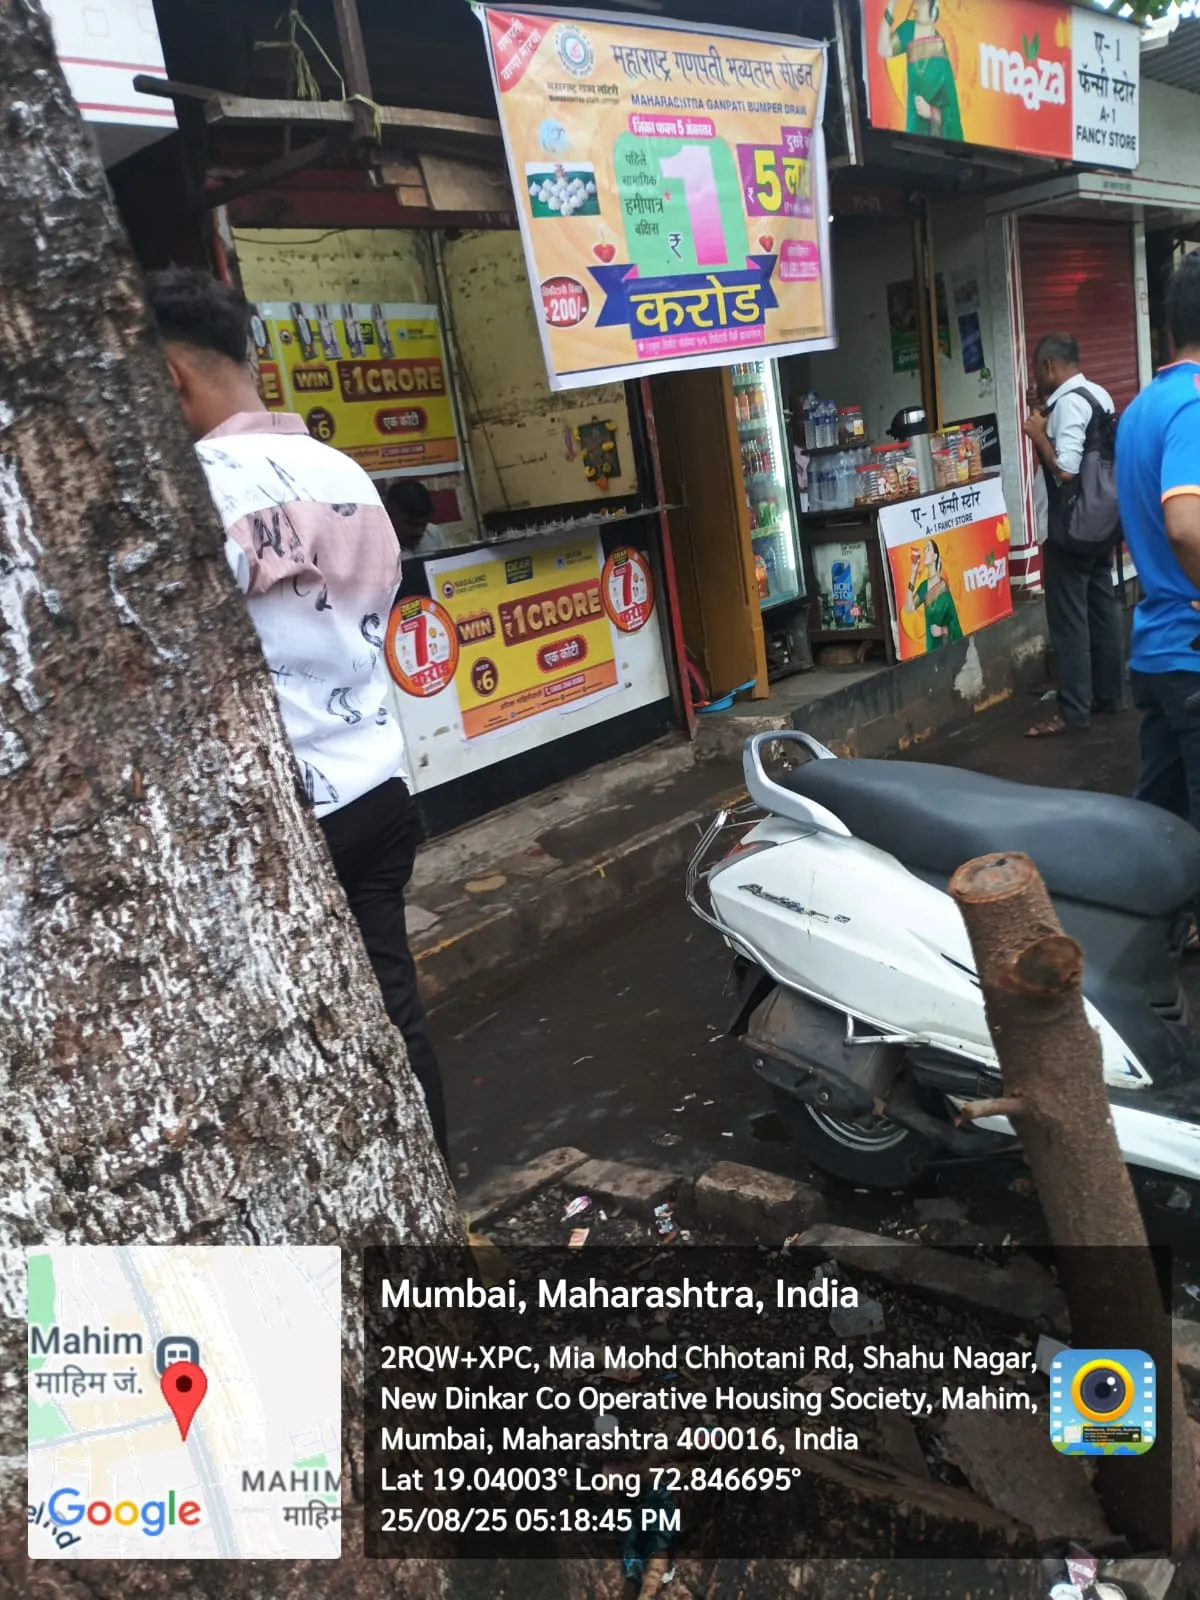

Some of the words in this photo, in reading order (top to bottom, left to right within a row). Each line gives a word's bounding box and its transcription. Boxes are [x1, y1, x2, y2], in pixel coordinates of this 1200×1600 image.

[610, 45, 672, 83] महाराष्ट्र
[673, 44, 730, 87] गणपती
[726, 57, 781, 90] भव्यतम
[776, 53, 817, 94] सोडत
[978, 42, 1066, 111] maaza
[1112, 70, 1136, 105] स्टोर
[707, 99, 745, 112] GANPATI
[748, 101, 783, 114] BUMPER
[785, 105, 807, 116] DRAW
[677, 120, 684, 135] 5
[1076, 125, 1107, 145] FANCY
[1109, 131, 1136, 151] STORE
[625, 149, 647, 166] पहिले
[754, 150, 782, 212] 5
[624, 192, 664, 215] हमीपात्र
[659, 145, 728, 265] 1
[630, 275, 761, 333] करोड
[296, 371, 329, 388] WIN
[318, 420, 330, 438] 6
[383, 416, 398, 431] एक
[399, 411, 420, 426] कोटी
[961, 487, 981, 509] स्टोर
[937, 519, 955, 532] FANCY
[955, 513, 973, 527] STORE
[459, 618, 492, 641] WIN
[544, 651, 560, 667] एक
[560, 641, 580, 659] कोटी
[482, 671, 494, 691] 6
